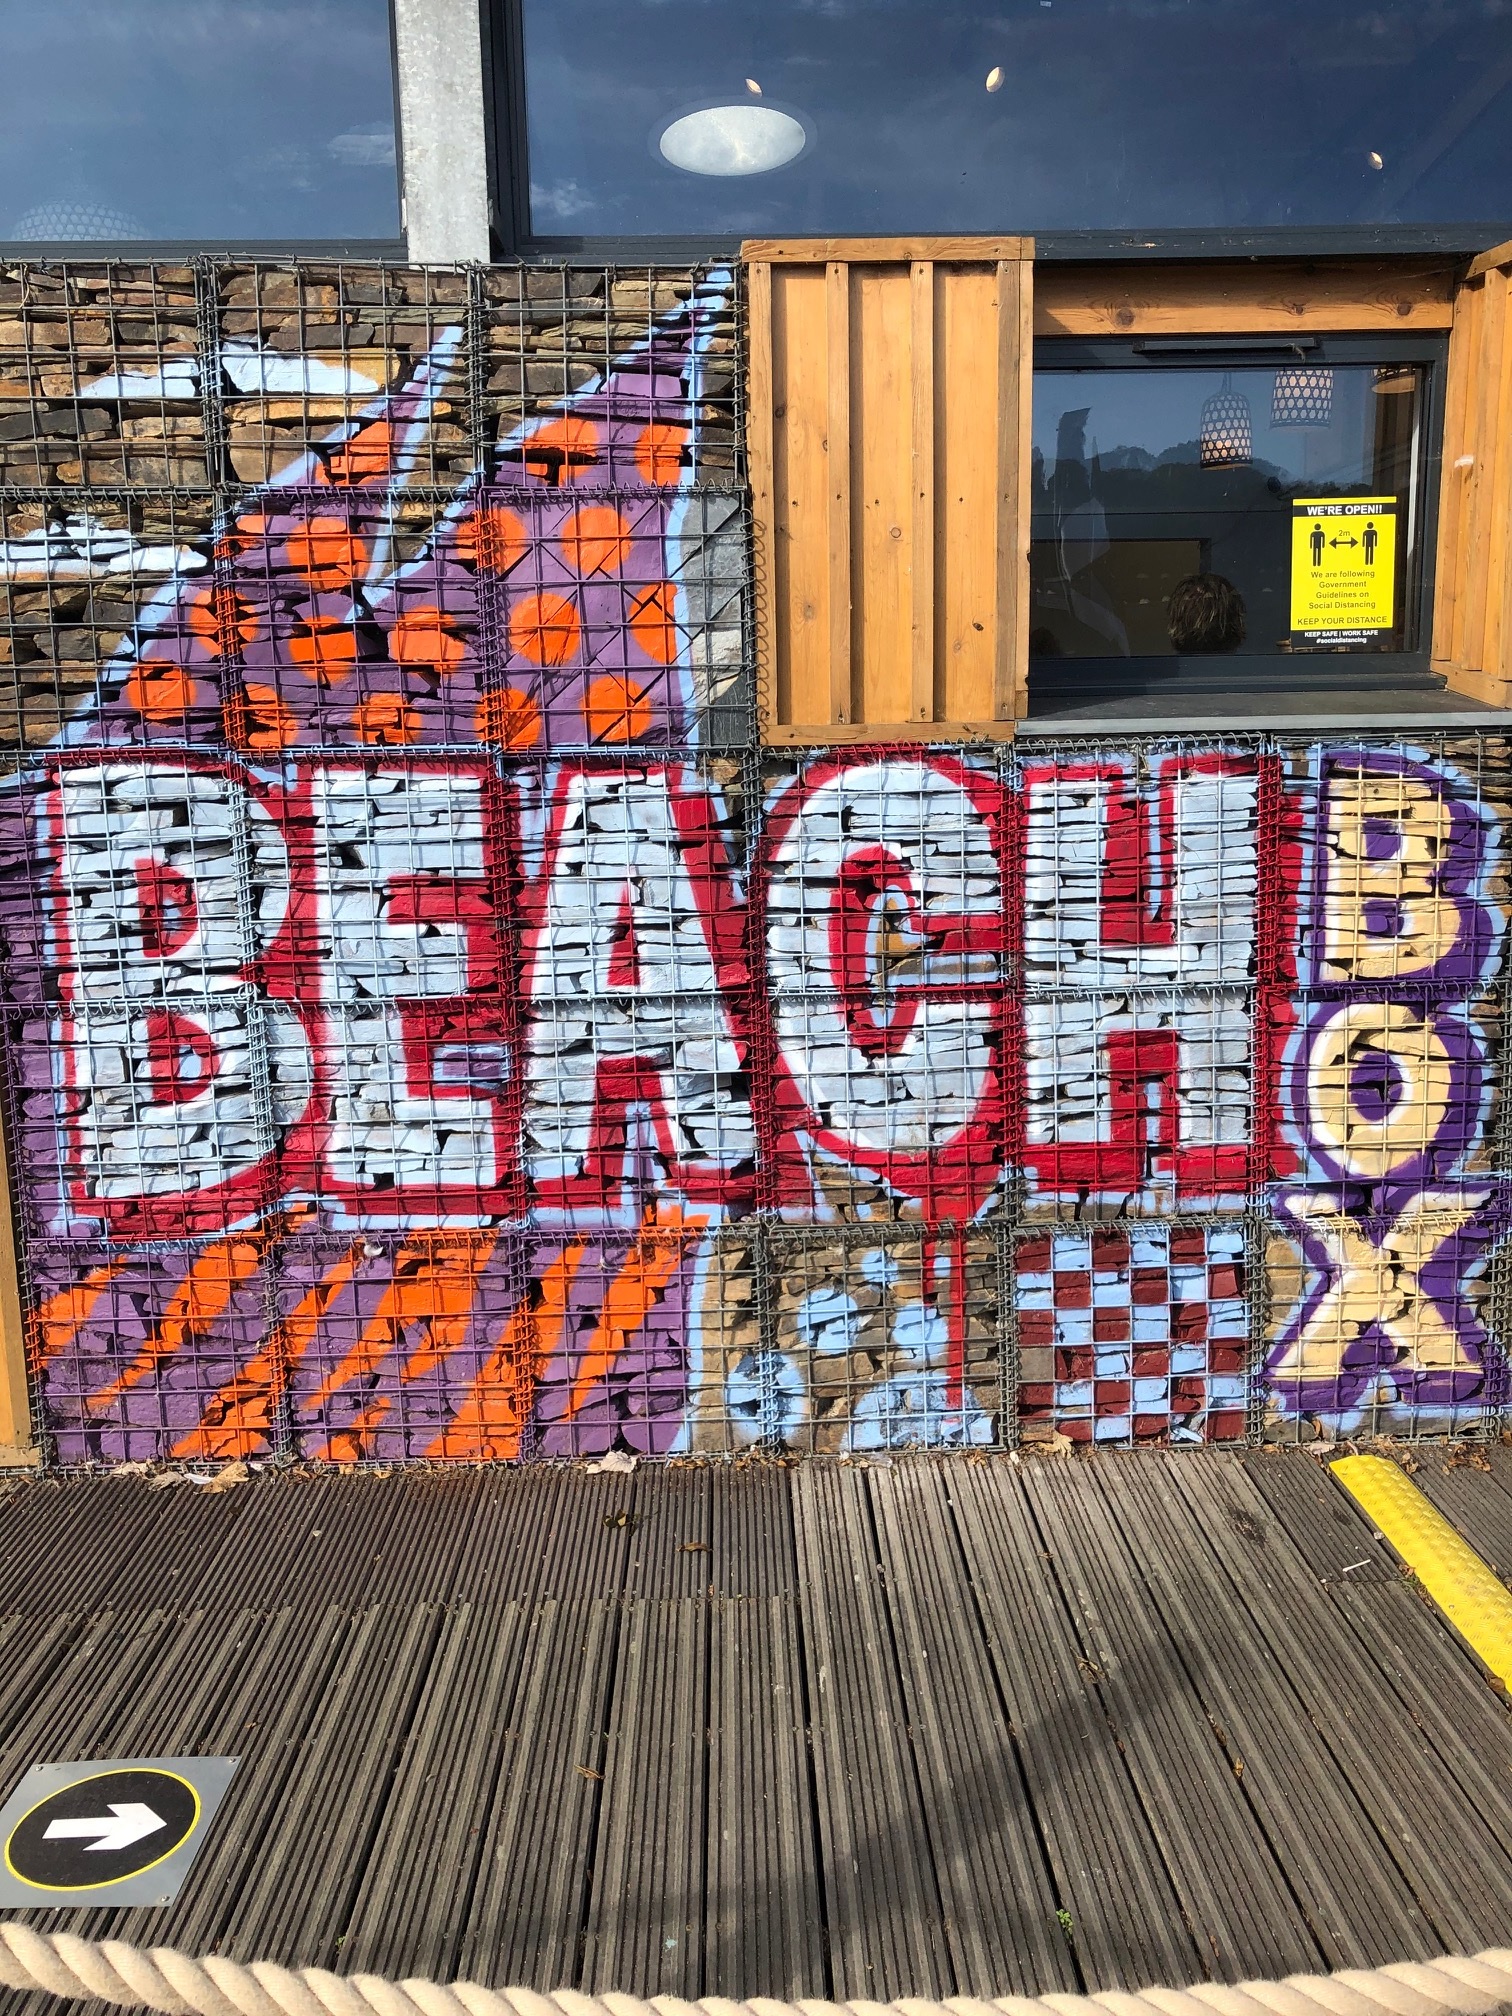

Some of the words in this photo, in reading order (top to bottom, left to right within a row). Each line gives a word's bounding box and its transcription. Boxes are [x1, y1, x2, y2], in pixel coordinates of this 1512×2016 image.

[1306, 506, 1344, 516] WE'RE
[1345, 505, 1383, 515] OPEN!!
[1338, 529, 1351, 537] 2m
[1339, 570, 1376, 579] following
[1318, 580, 1367, 589] Government
[1334, 601, 1376, 609] Distancing
[1297, 617, 1320, 625] KEEP
[1321, 617, 1345, 625] YOUR
[1346, 615, 1388, 624] DISTANCE
[1316, 636, 1368, 644] #socialdistancing
[50, 750, 1265, 1230] BEACH
[1270, 752, 1495, 1402] BOX
